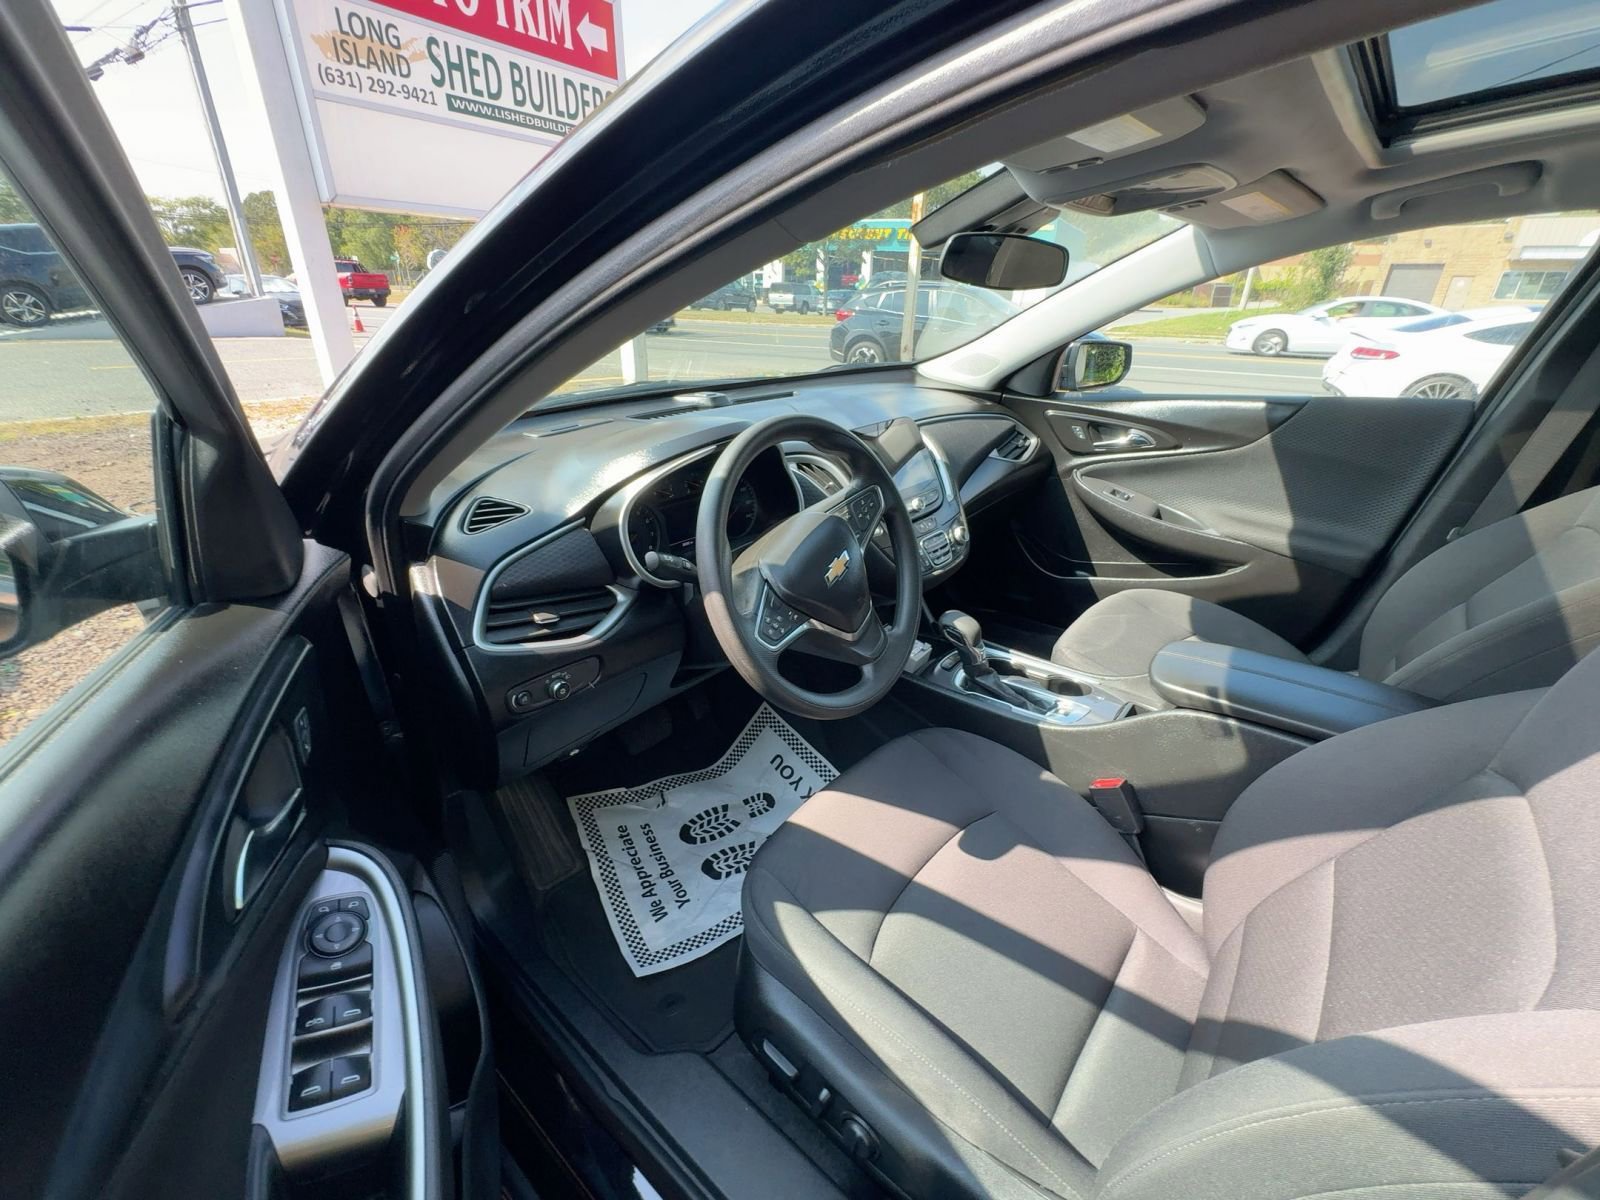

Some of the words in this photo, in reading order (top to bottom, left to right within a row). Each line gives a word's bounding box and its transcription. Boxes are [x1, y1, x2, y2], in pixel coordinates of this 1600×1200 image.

[334, 6, 402, 50] LONG
[331, 36, 411, 78] ISLAND
[317, 62, 363, 93] (631)
[366, 76, 438, 106] 292-9421
[426, 36, 503, 102] SHED
[509, 60, 614, 122] BUILDE
[451, 97, 575, 136] WWW.LISHEDBUILDE
[769, 754, 804, 792] YOU
[617, 824, 658, 898] Appreciate
[640, 823, 675, 880] Business
[649, 899, 668, 923] We
[667, 879, 691, 909] Your
